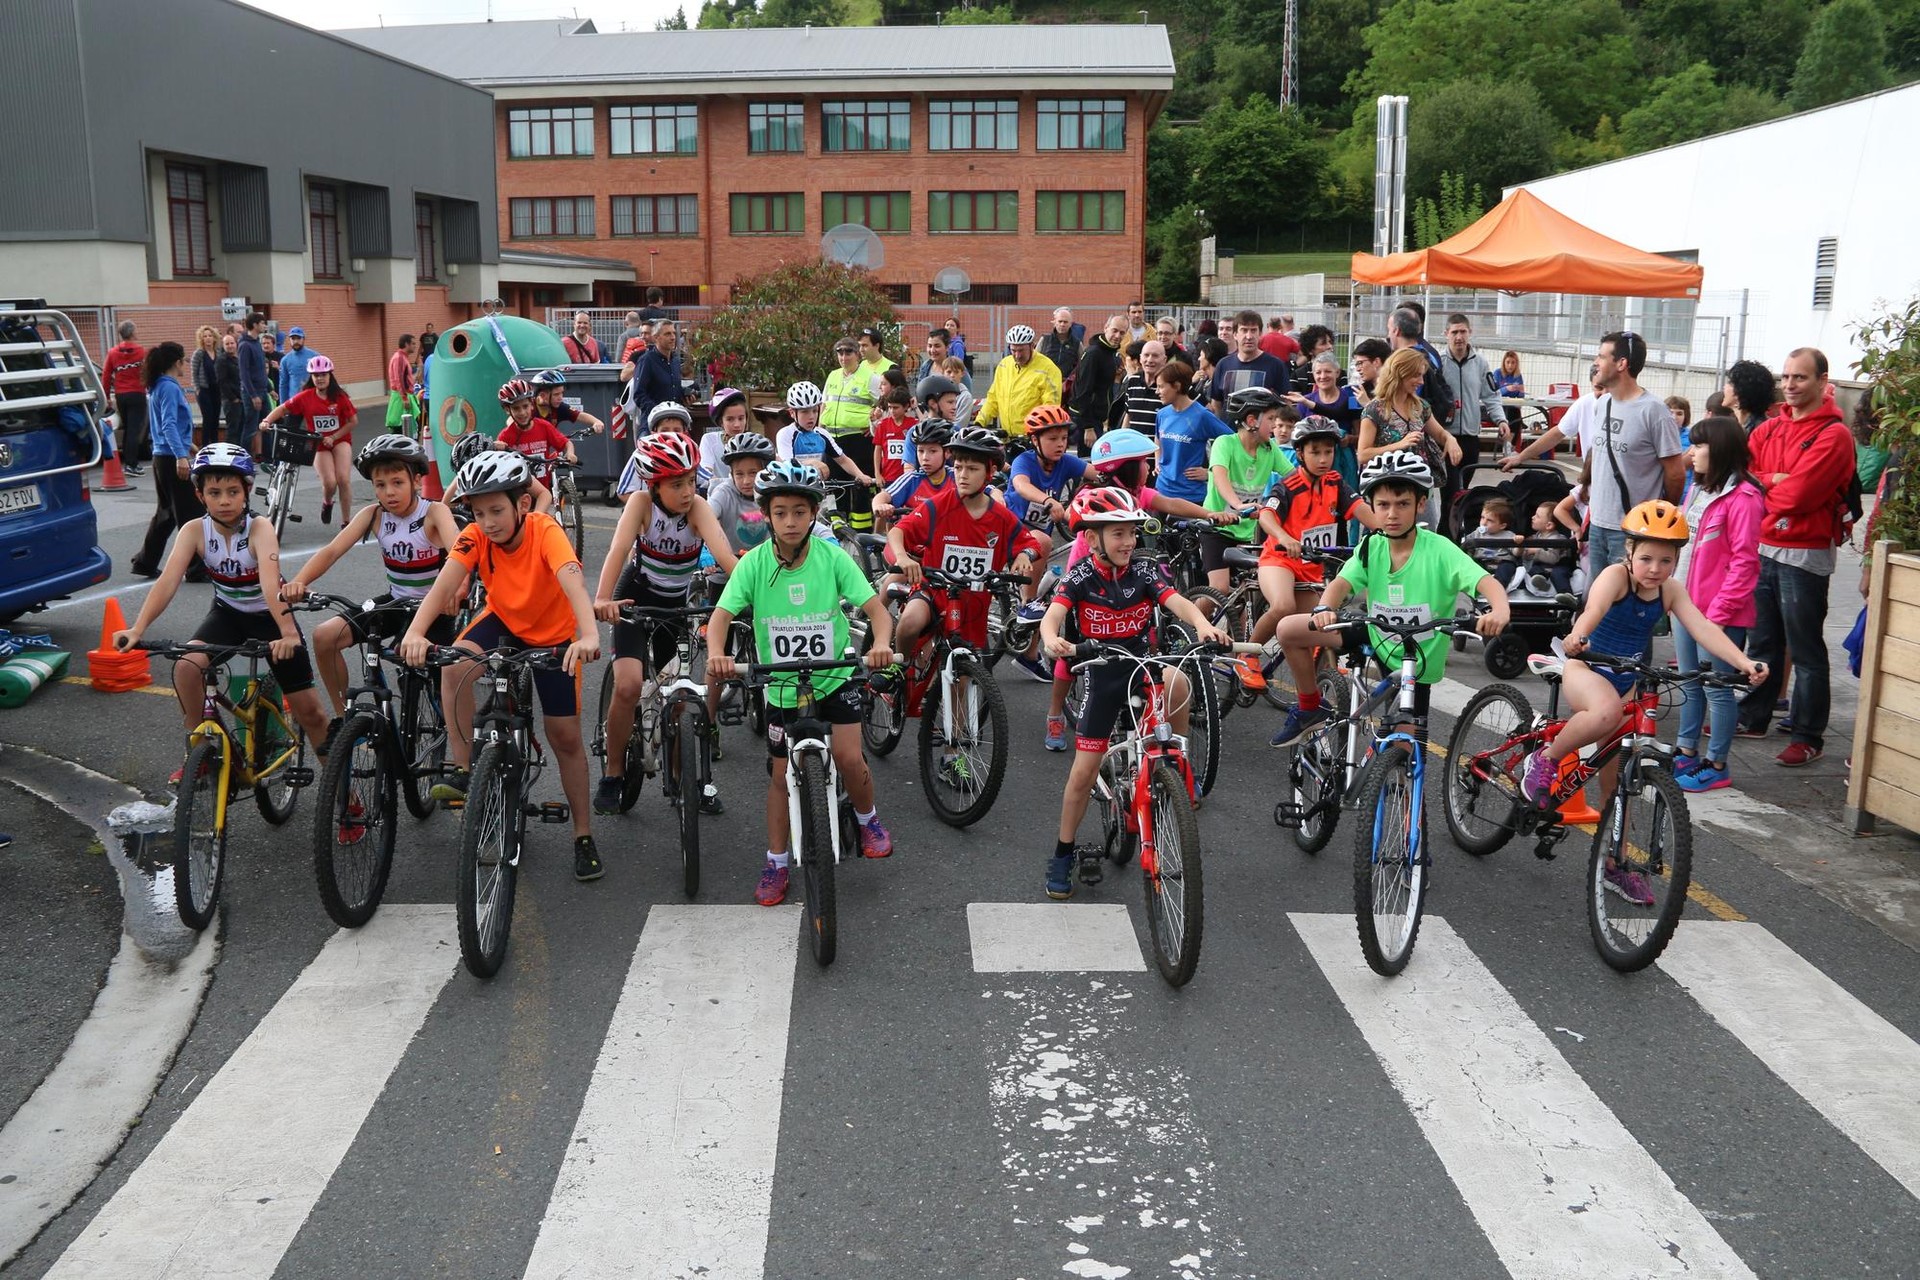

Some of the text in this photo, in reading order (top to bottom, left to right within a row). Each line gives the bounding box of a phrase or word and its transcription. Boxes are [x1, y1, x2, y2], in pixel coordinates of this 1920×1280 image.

[316, 418, 336, 429] 020
[890, 444, 904, 455] 03
[12, 488, 34, 506] FDV
[1029, 510, 1052, 524] 02
[1303, 532, 1331, 548] 010
[945, 554, 986, 576] 035
[774, 633, 827, 658] 026
